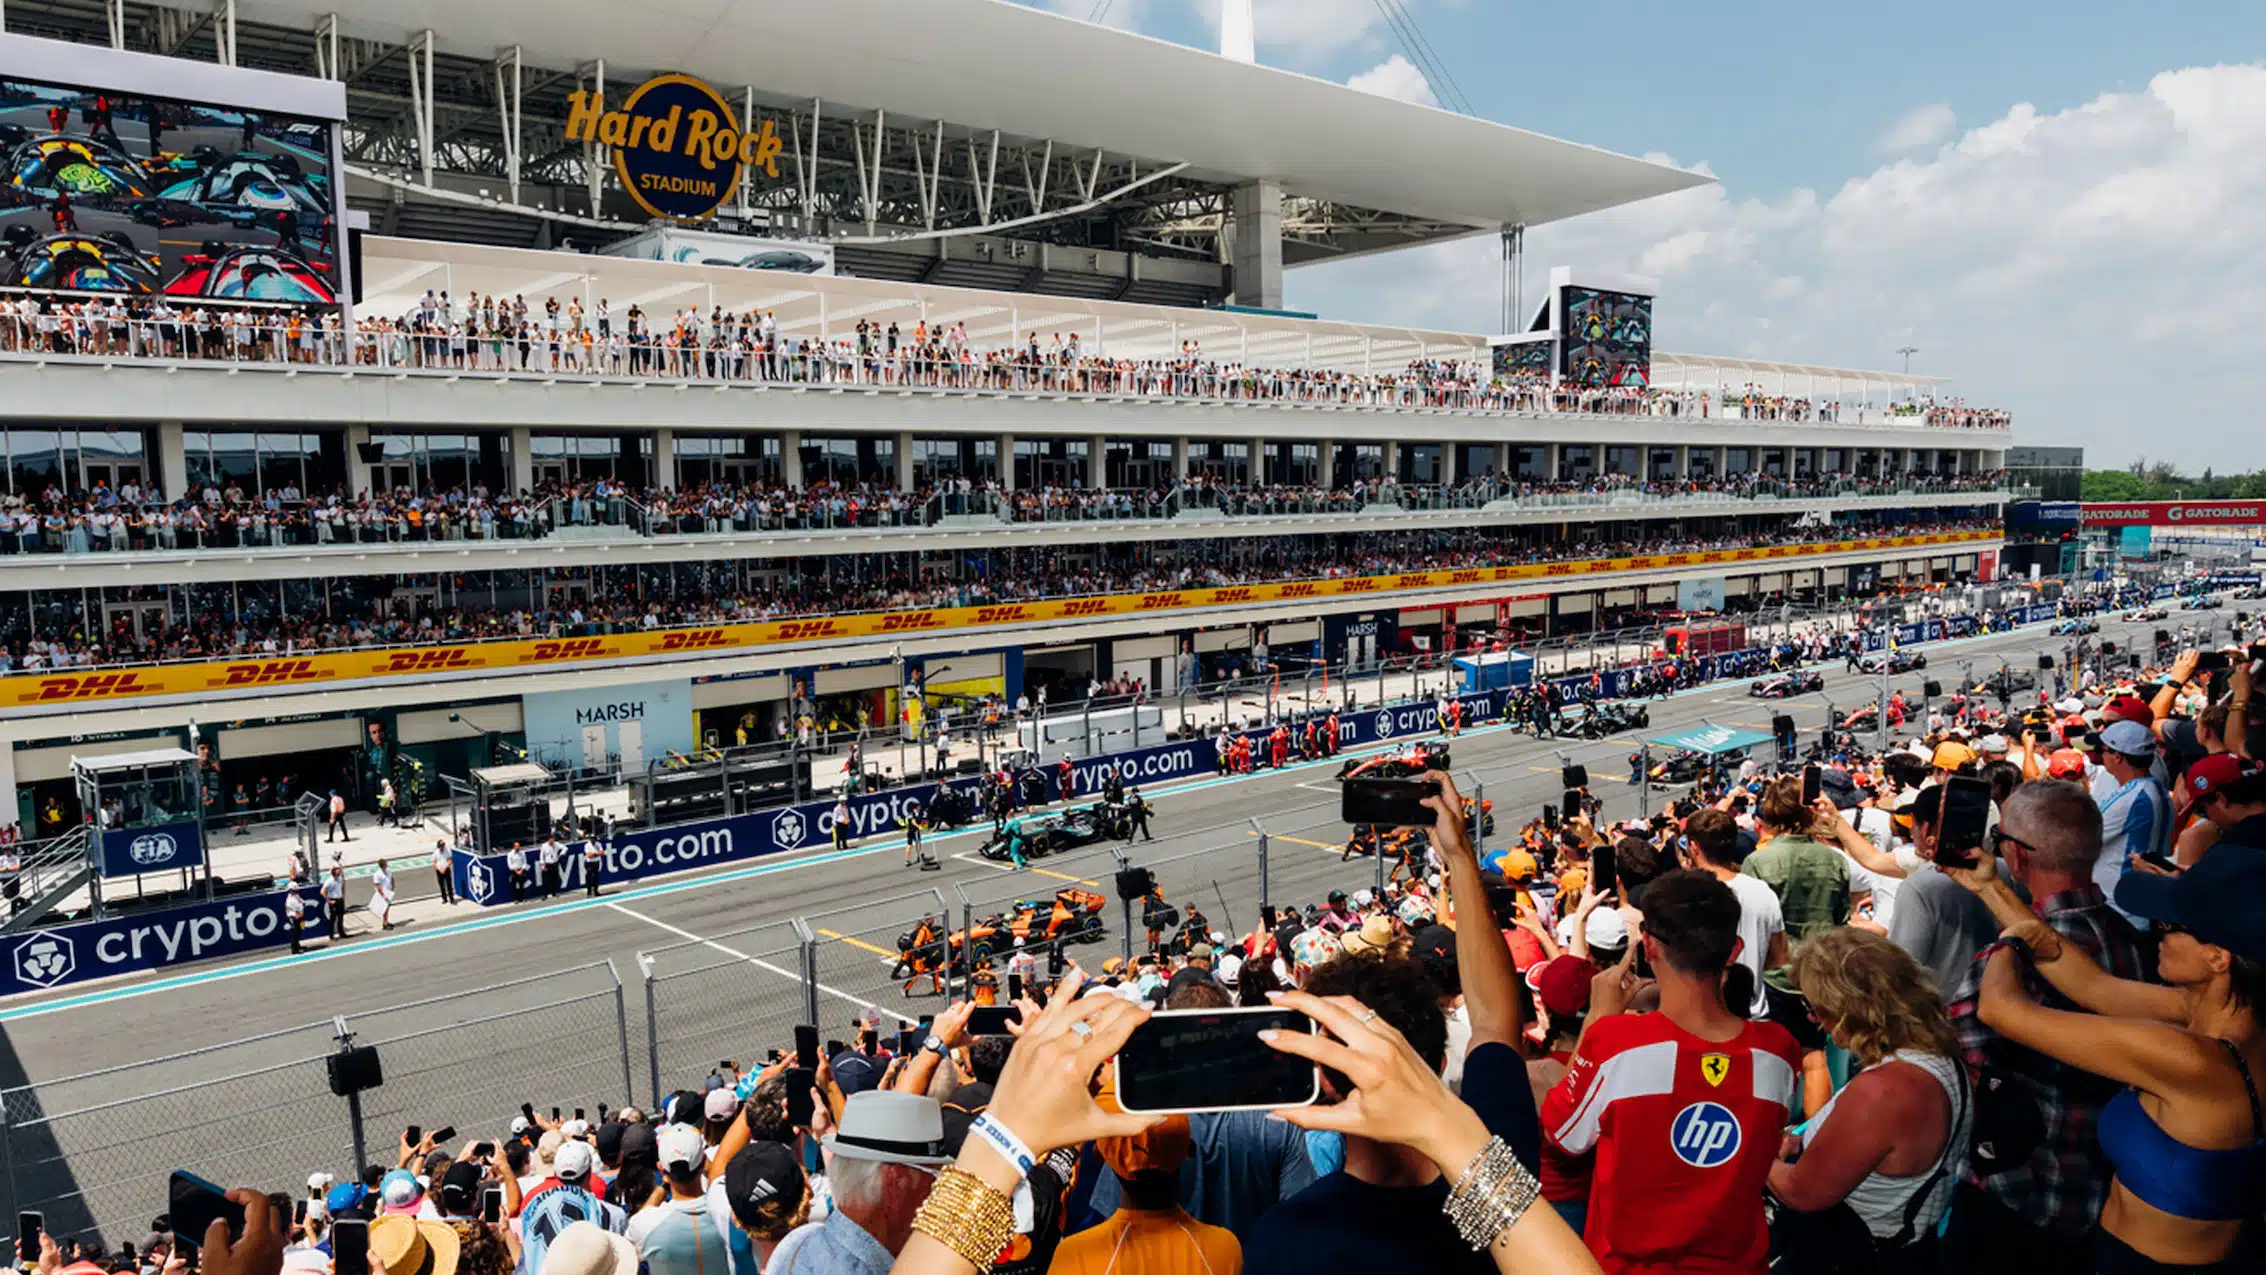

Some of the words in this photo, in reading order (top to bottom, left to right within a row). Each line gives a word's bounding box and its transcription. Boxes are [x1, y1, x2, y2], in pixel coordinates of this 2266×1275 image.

[564, 89, 682, 153] Hard
[684, 108, 783, 177] Rock
[640, 173, 717, 197] STADIUM
[2081, 509, 2149, 520] GATORADE
[2185, 507, 2259, 518] GATORADE
[1548, 564, 1571, 575] DHL
[1590, 561, 1612, 571] DHL
[1342, 579, 1374, 592] DHL
[1400, 575, 1429, 587] DHL
[1452, 571, 1480, 583] DHL
[1214, 588, 1252, 602] DHL
[1281, 583, 1317, 597] DHL
[1063, 598, 1108, 616] DHL
[1142, 593, 1183, 609] DHL
[882, 612, 937, 630] DHL
[976, 605, 1027, 622] DHL
[777, 619, 839, 639] DHL
[1345, 621, 1378, 637] MARSH
[661, 629, 730, 650] DHL
[532, 638, 608, 661] DHL
[388, 649, 472, 671] DHL
[225, 660, 320, 685] DHL
[39, 673, 145, 700] DHL
[576, 702, 644, 724] MARSH
[1398, 698, 1491, 730] crypom
[134, 838, 175, 858] FIA
[96, 898, 331, 965] crypto.c
[1679, 1103, 1733, 1165] hp
